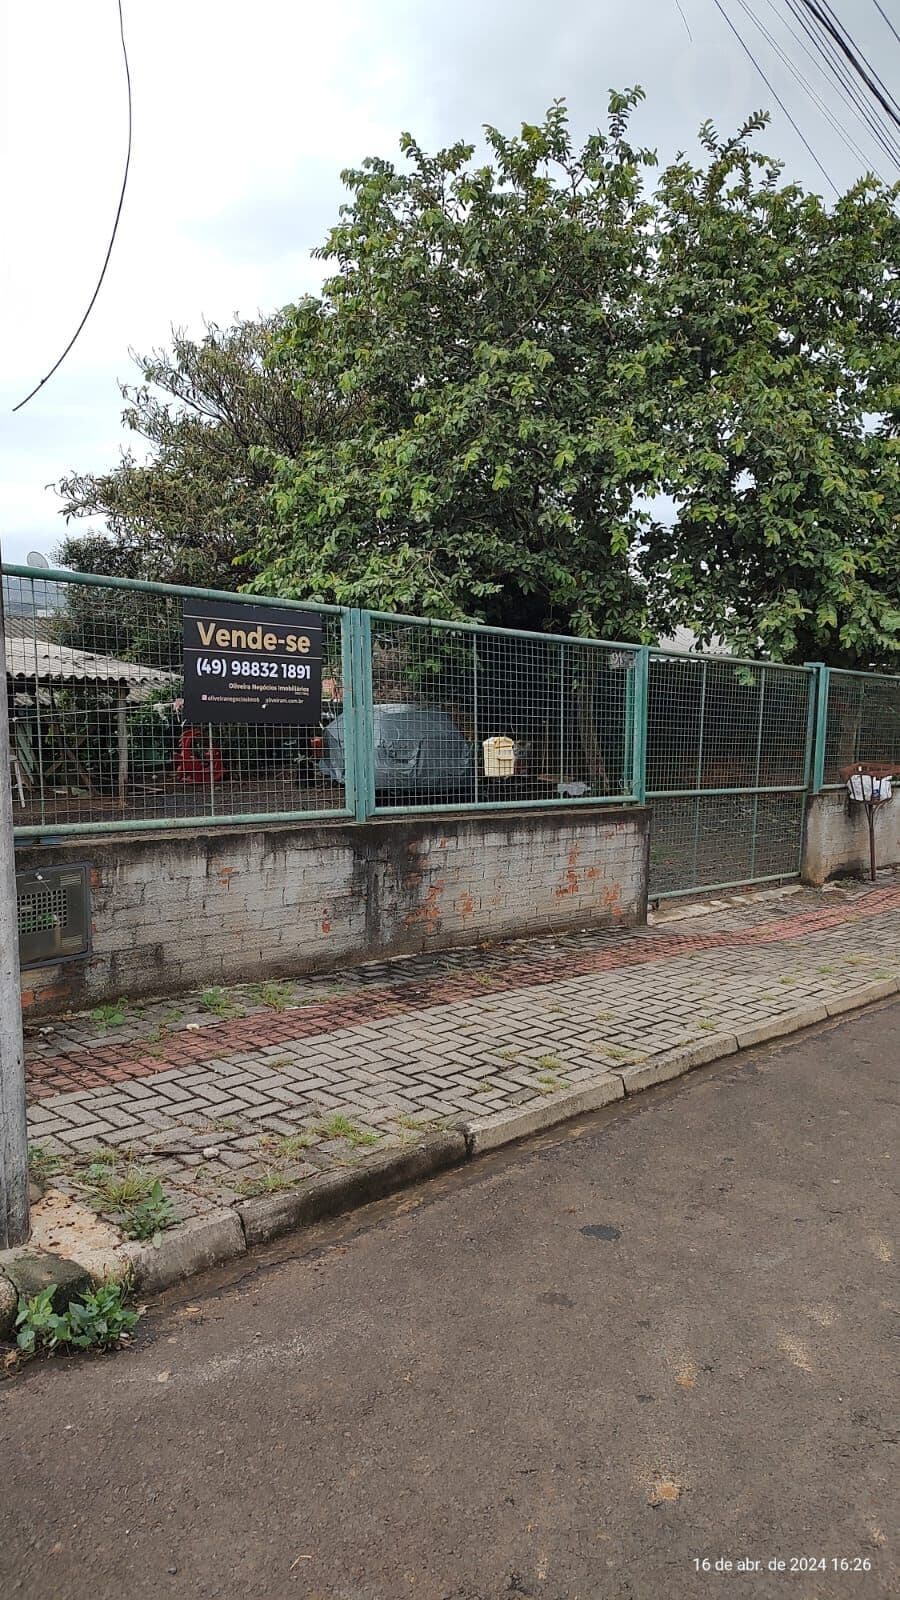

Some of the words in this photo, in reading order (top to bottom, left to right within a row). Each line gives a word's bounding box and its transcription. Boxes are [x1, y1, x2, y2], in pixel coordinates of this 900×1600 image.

[196, 621, 311, 654] Vende-se
[196, 657, 227, 678] (49)
[231, 660, 278, 678] 98832
[281, 663, 311, 680] 1891
[228, 682, 251, 691] Oliveira
[252, 683, 277, 692] Negócios
